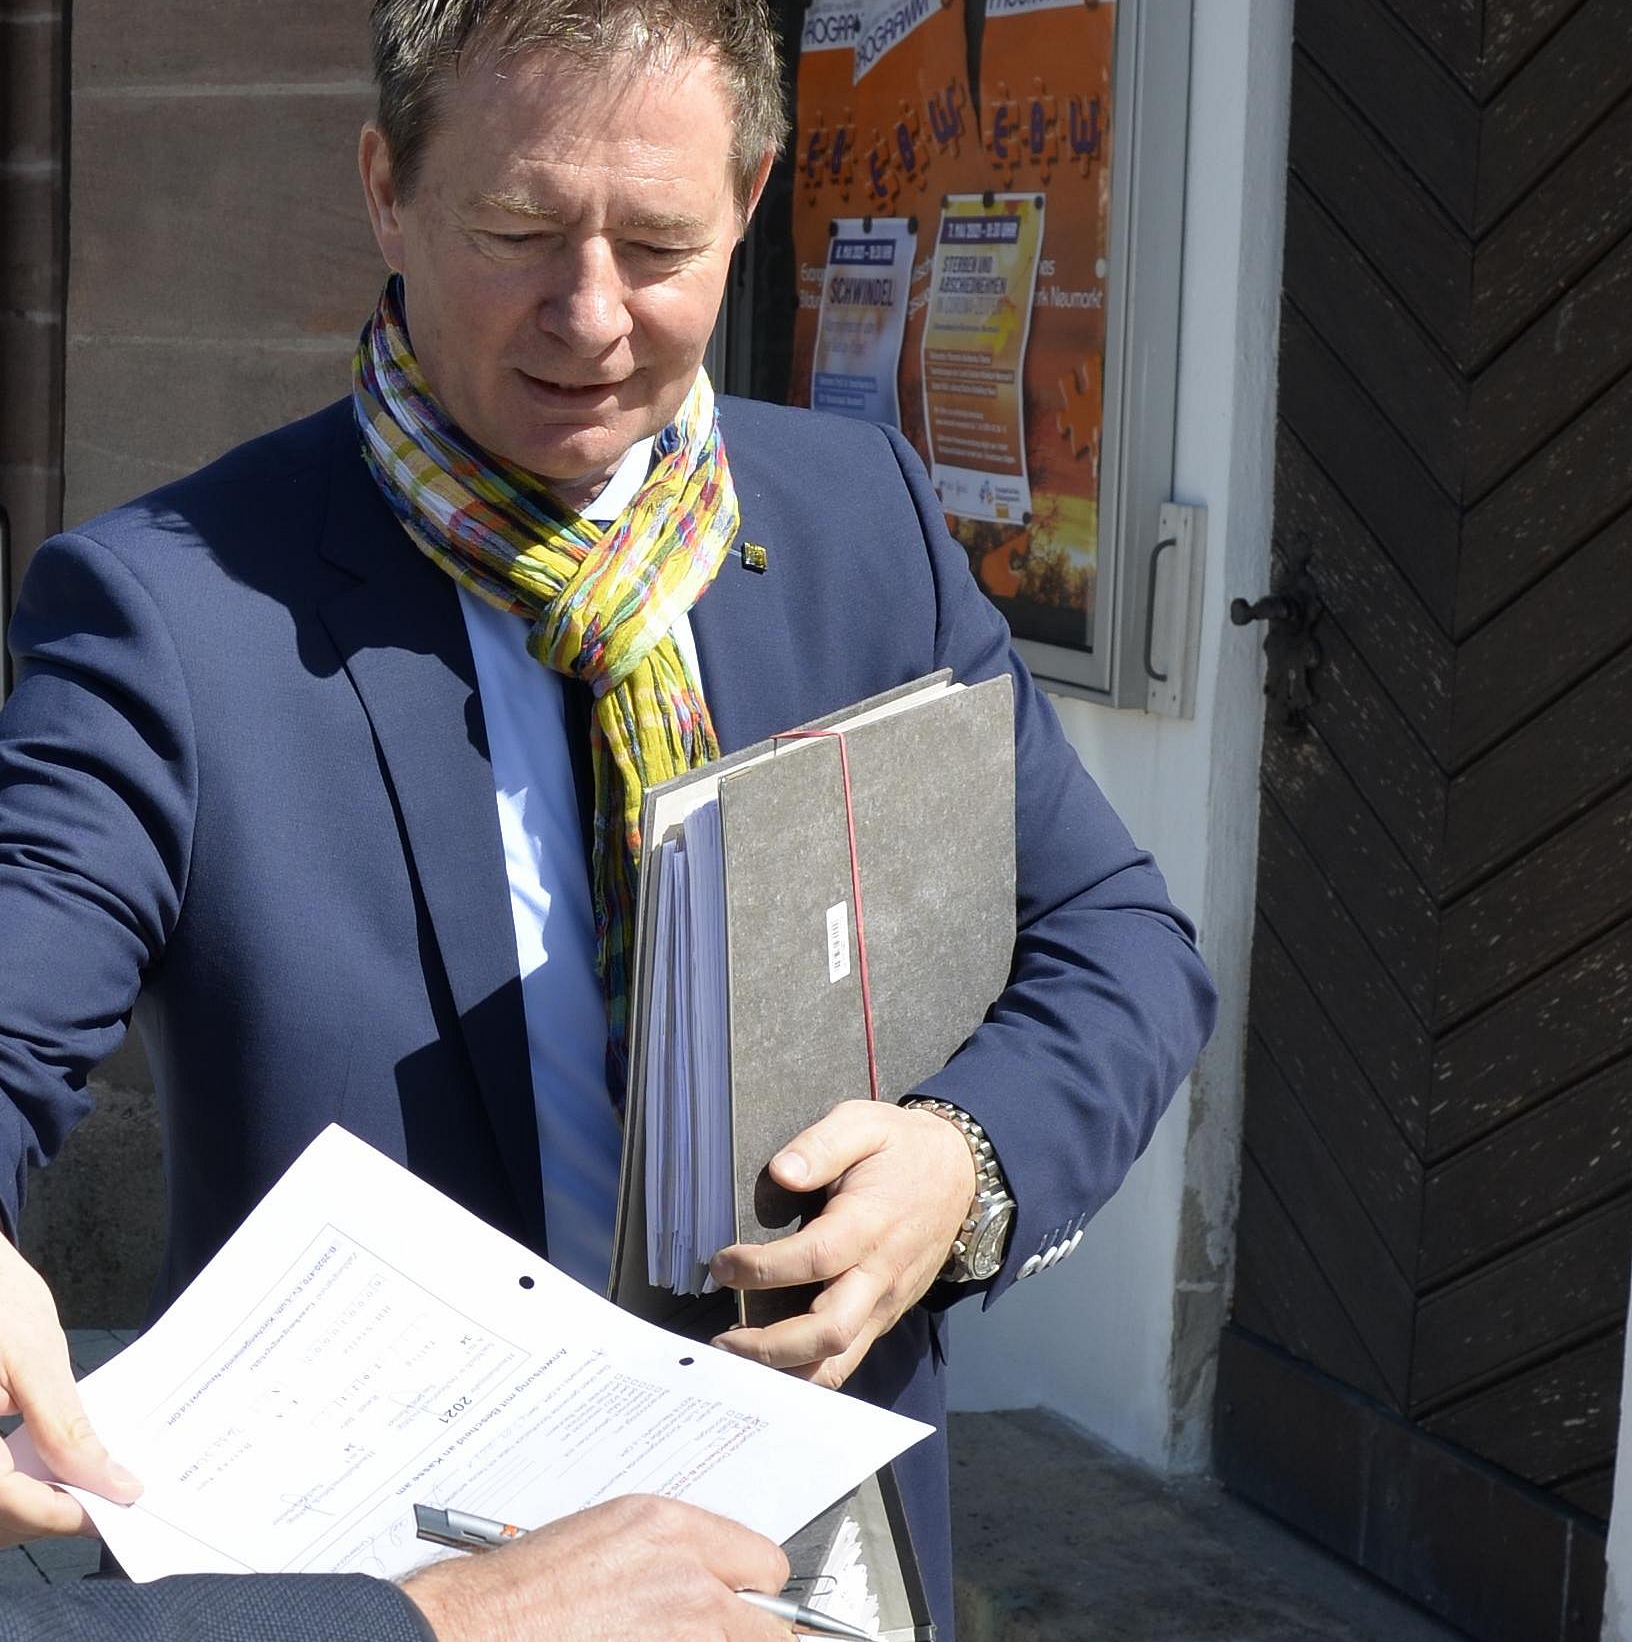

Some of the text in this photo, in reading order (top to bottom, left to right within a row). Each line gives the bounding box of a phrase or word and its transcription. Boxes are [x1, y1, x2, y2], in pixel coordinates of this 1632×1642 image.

[830, 276, 894, 307] SCHWINDEL
[394, 1347, 567, 1497] Anweisung mit Bescheid an Kasse am
[435, 1392, 472, 1426] 2021
